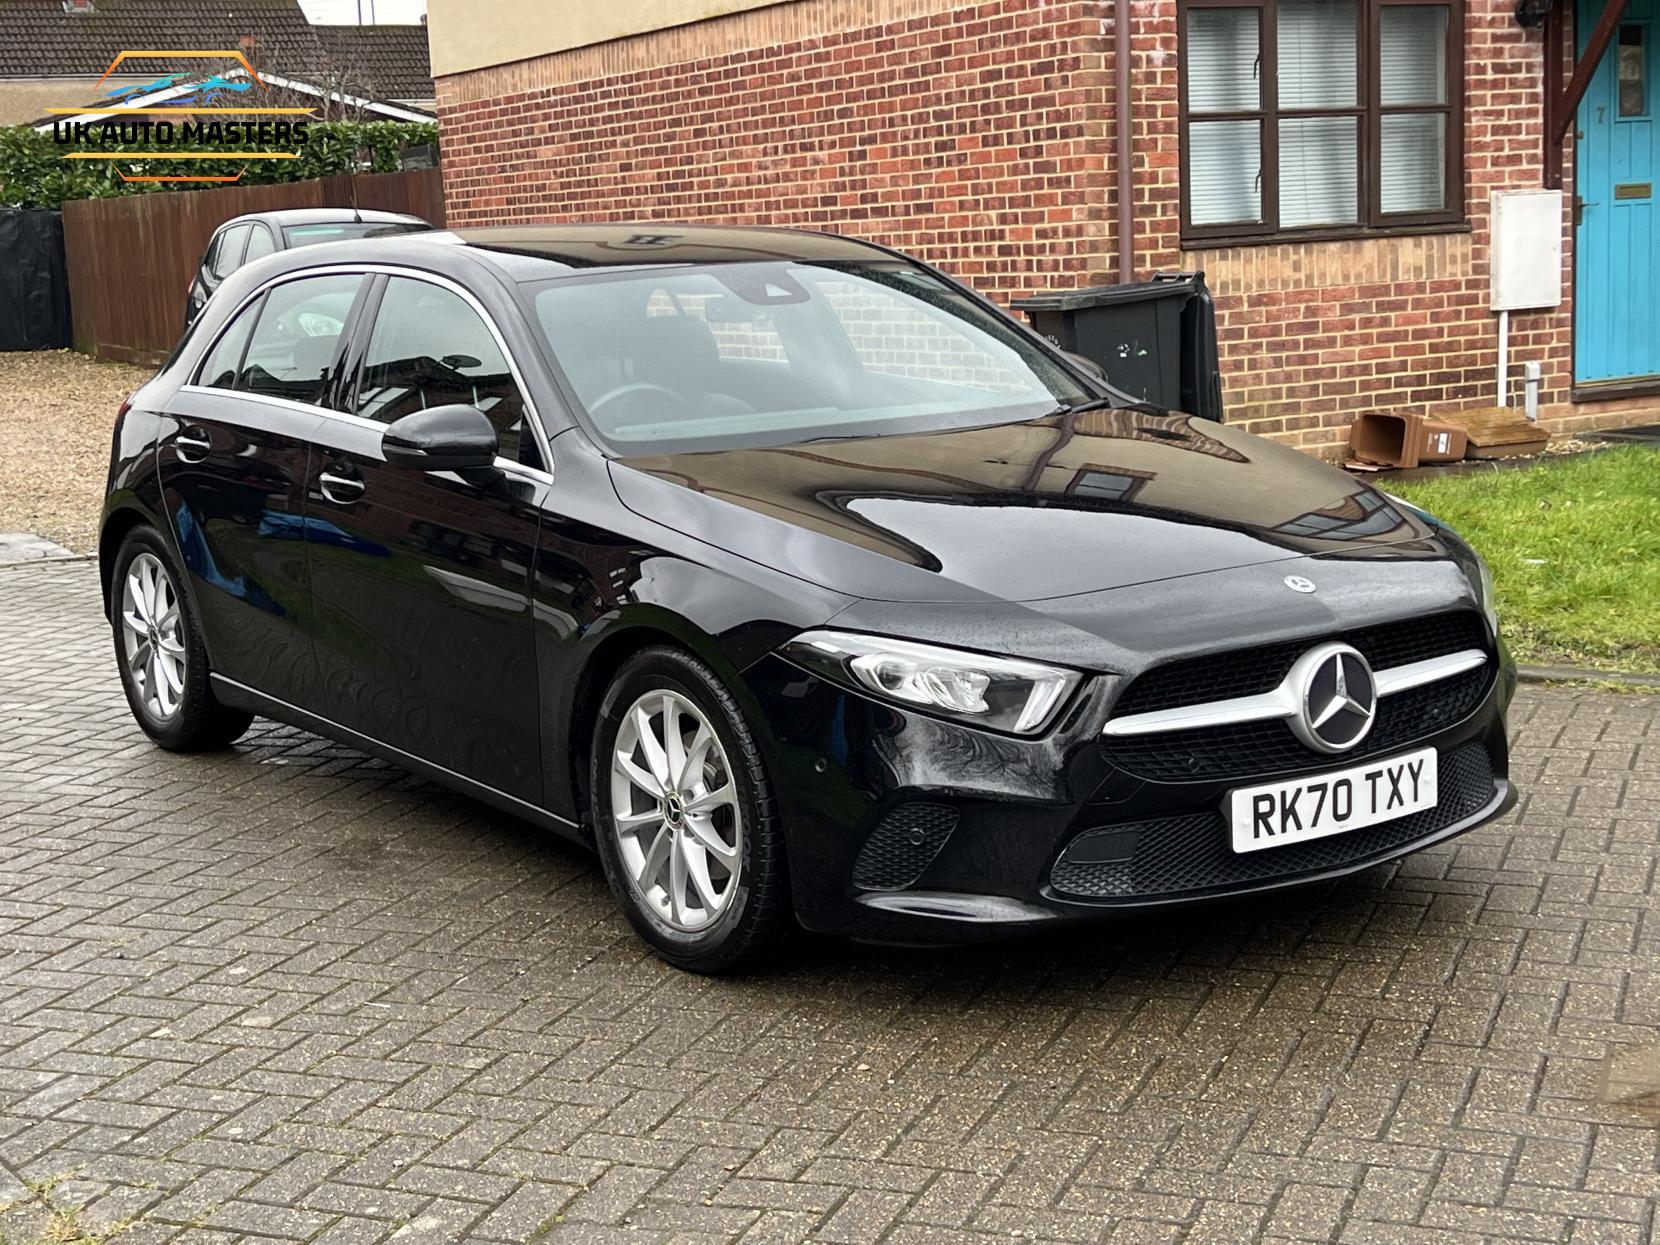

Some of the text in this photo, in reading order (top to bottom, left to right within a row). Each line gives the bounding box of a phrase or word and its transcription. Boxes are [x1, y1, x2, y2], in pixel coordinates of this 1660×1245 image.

[1596, 106, 1606, 124] 7
[1252, 758, 1424, 839] RK70 TXY
